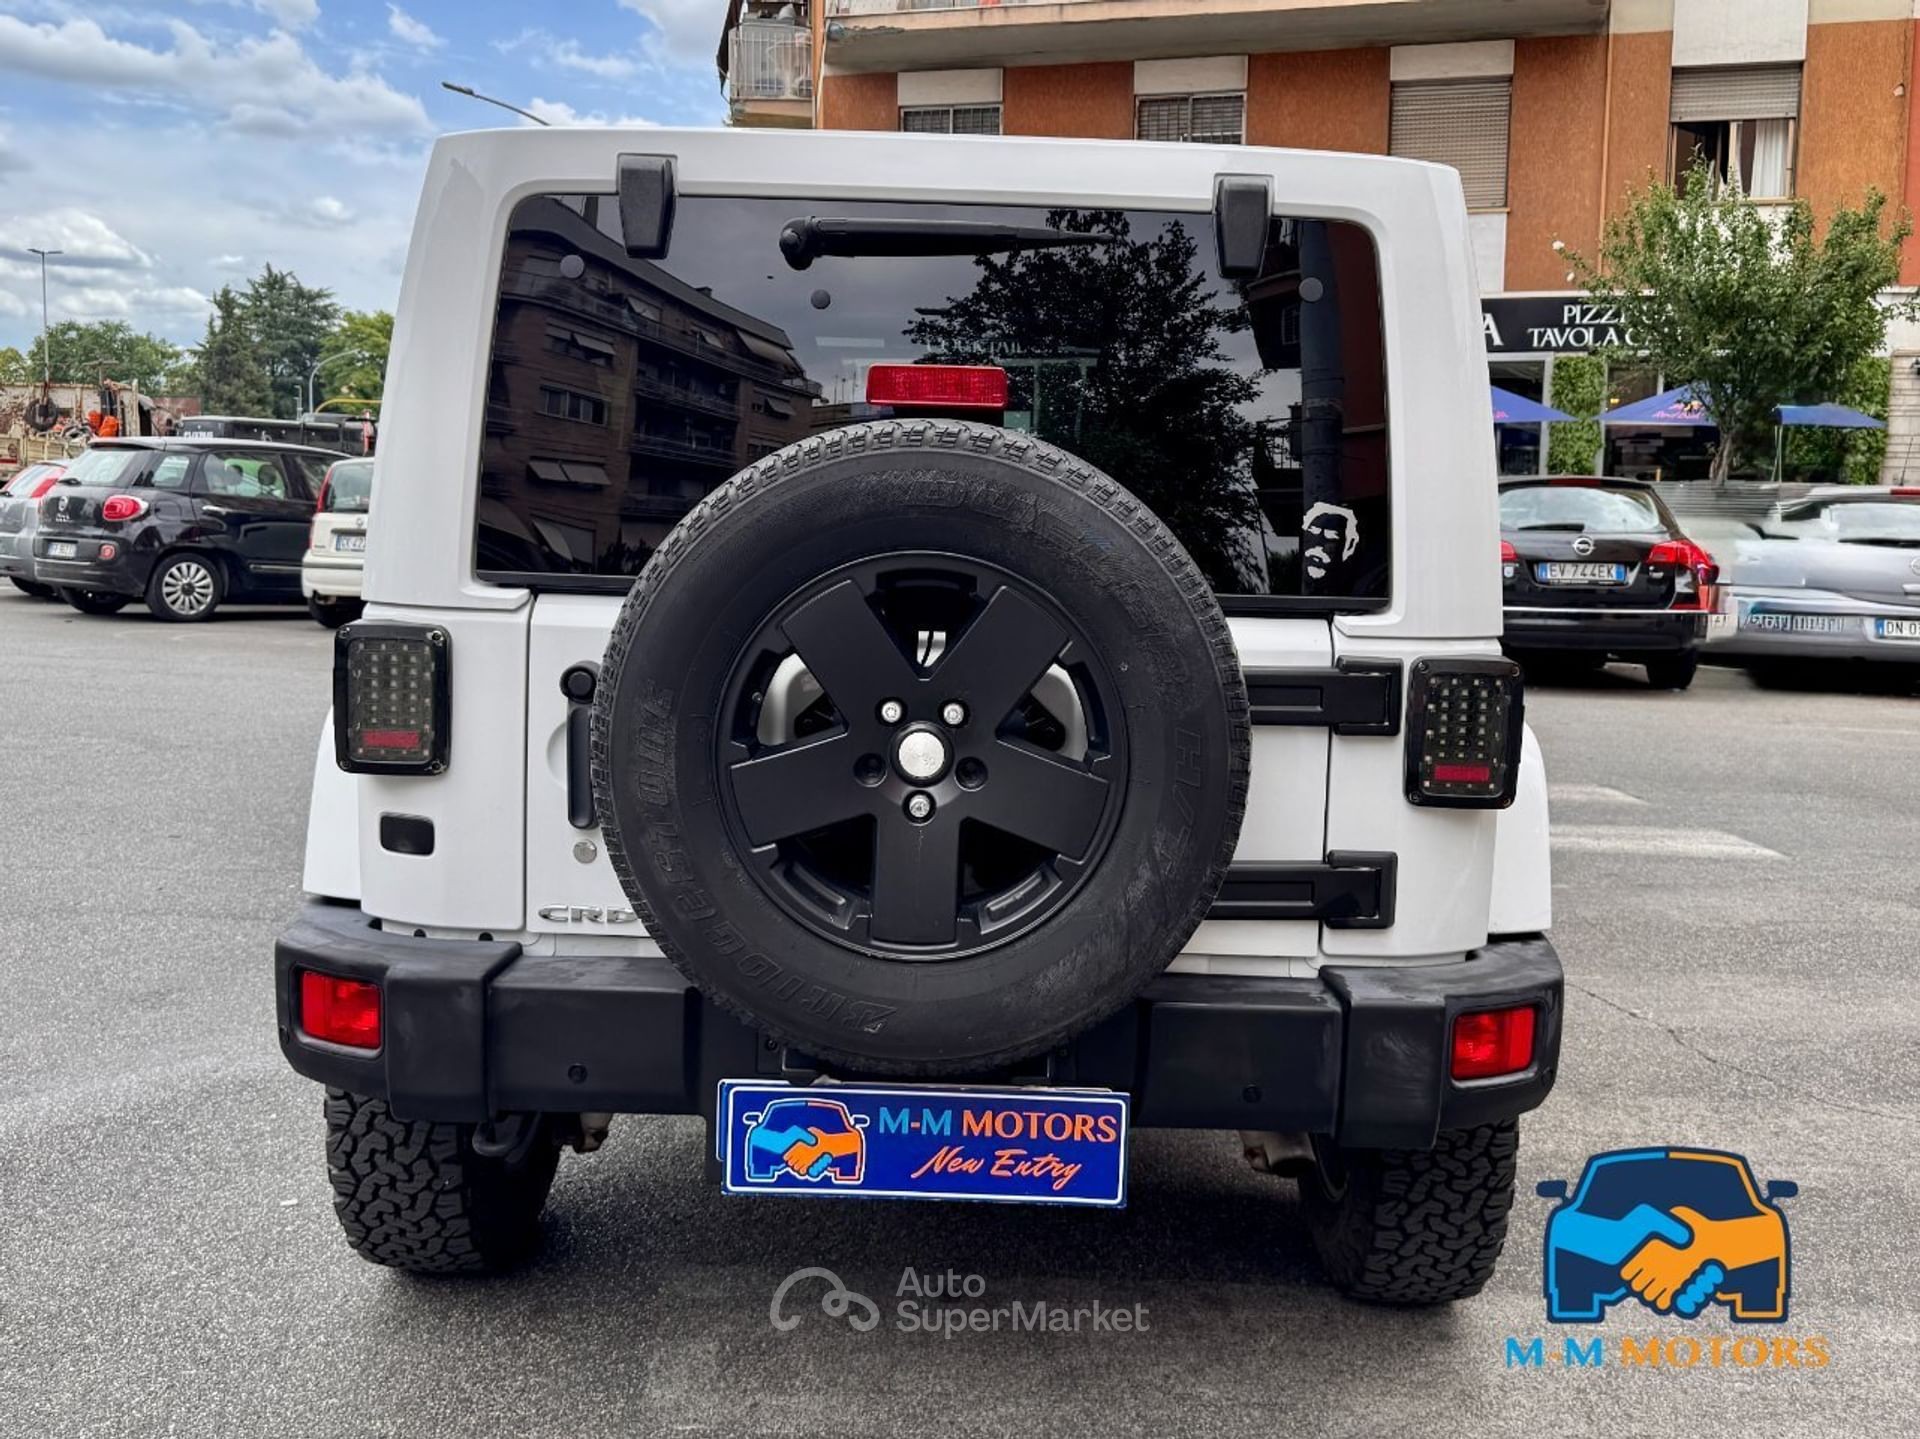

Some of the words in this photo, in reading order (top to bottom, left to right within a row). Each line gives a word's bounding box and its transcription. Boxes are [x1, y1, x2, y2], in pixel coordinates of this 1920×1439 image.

[1527, 327, 1619, 348] TAVOLA
[1550, 563, 1566, 578] EV
[1571, 564, 1614, 579] 744EK
[1886, 621, 1904, 636] DN
[538, 904, 638, 924] CRD
[879, 1107, 952, 1136] M-M
[962, 1109, 1118, 1144] MOTORS
[911, 1146, 986, 1179] New
[990, 1149, 1083, 1192] Entry
